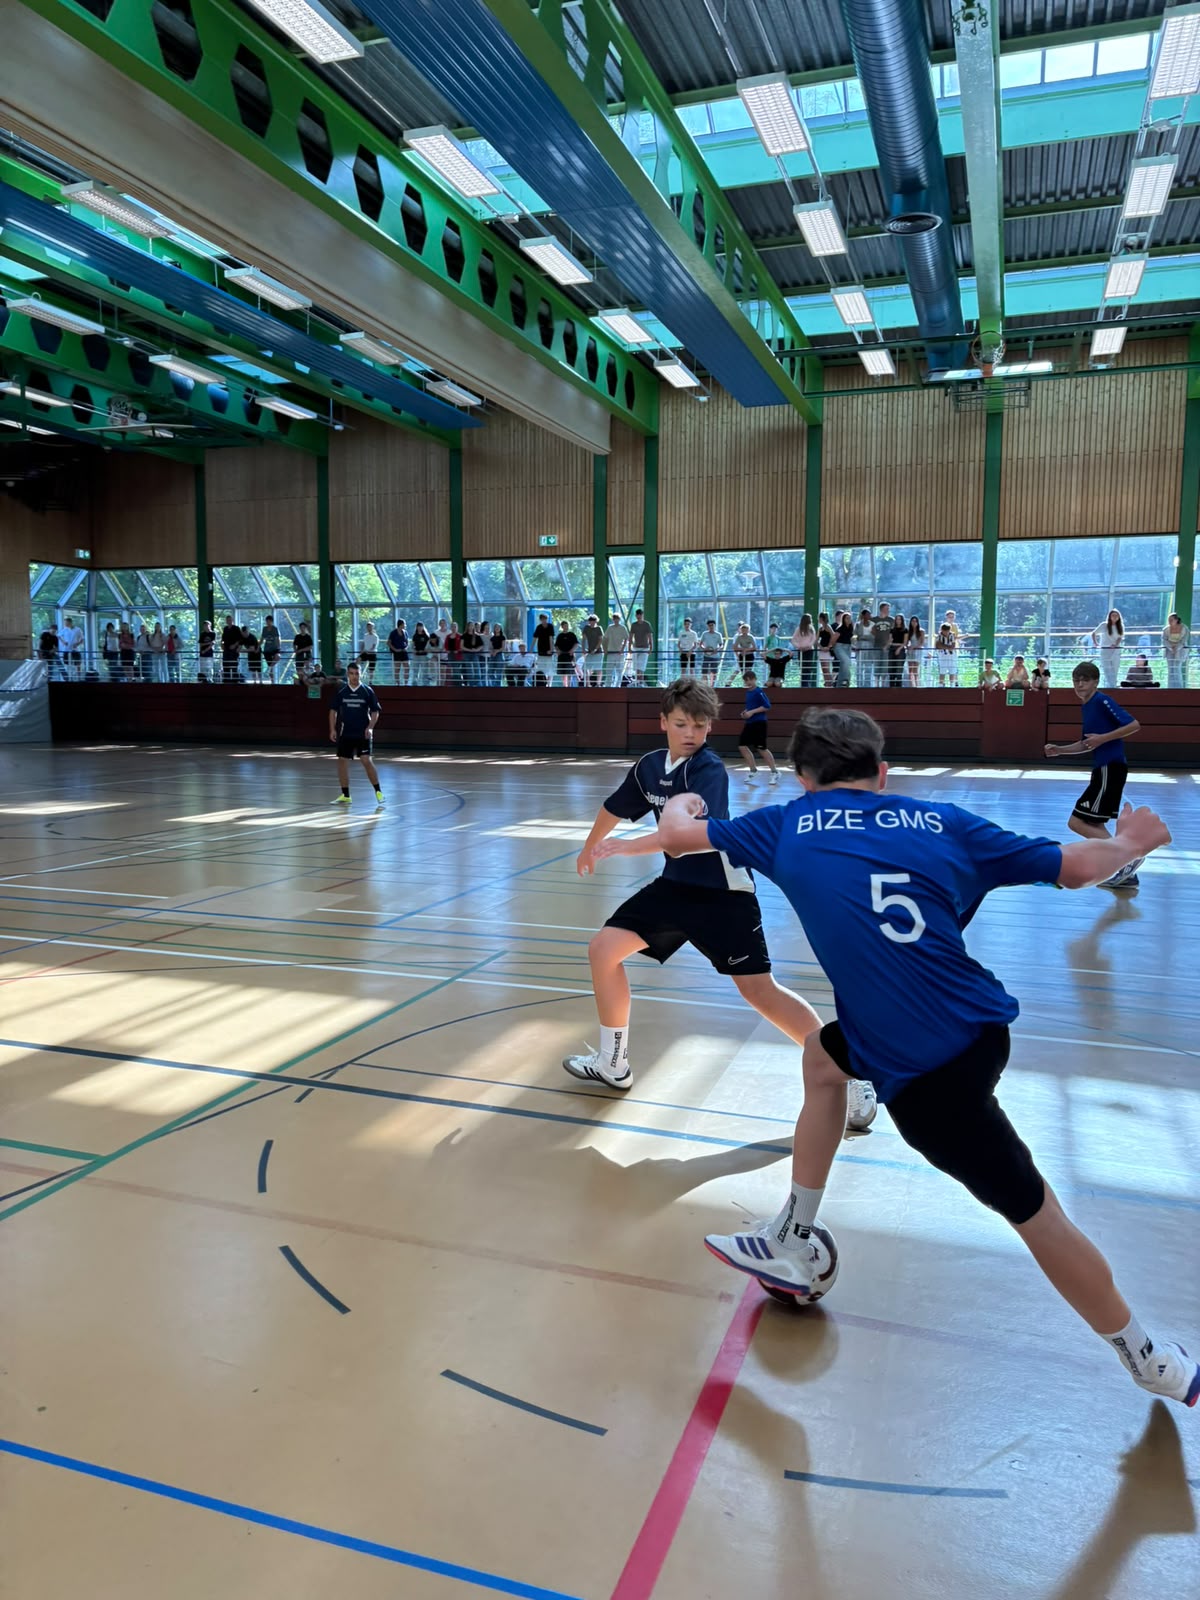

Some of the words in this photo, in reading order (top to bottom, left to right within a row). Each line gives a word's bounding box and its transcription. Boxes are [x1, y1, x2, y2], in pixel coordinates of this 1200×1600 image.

[796, 808, 866, 835] BIZE
[875, 808, 943, 834] GMS
[869, 872, 927, 944] 5
